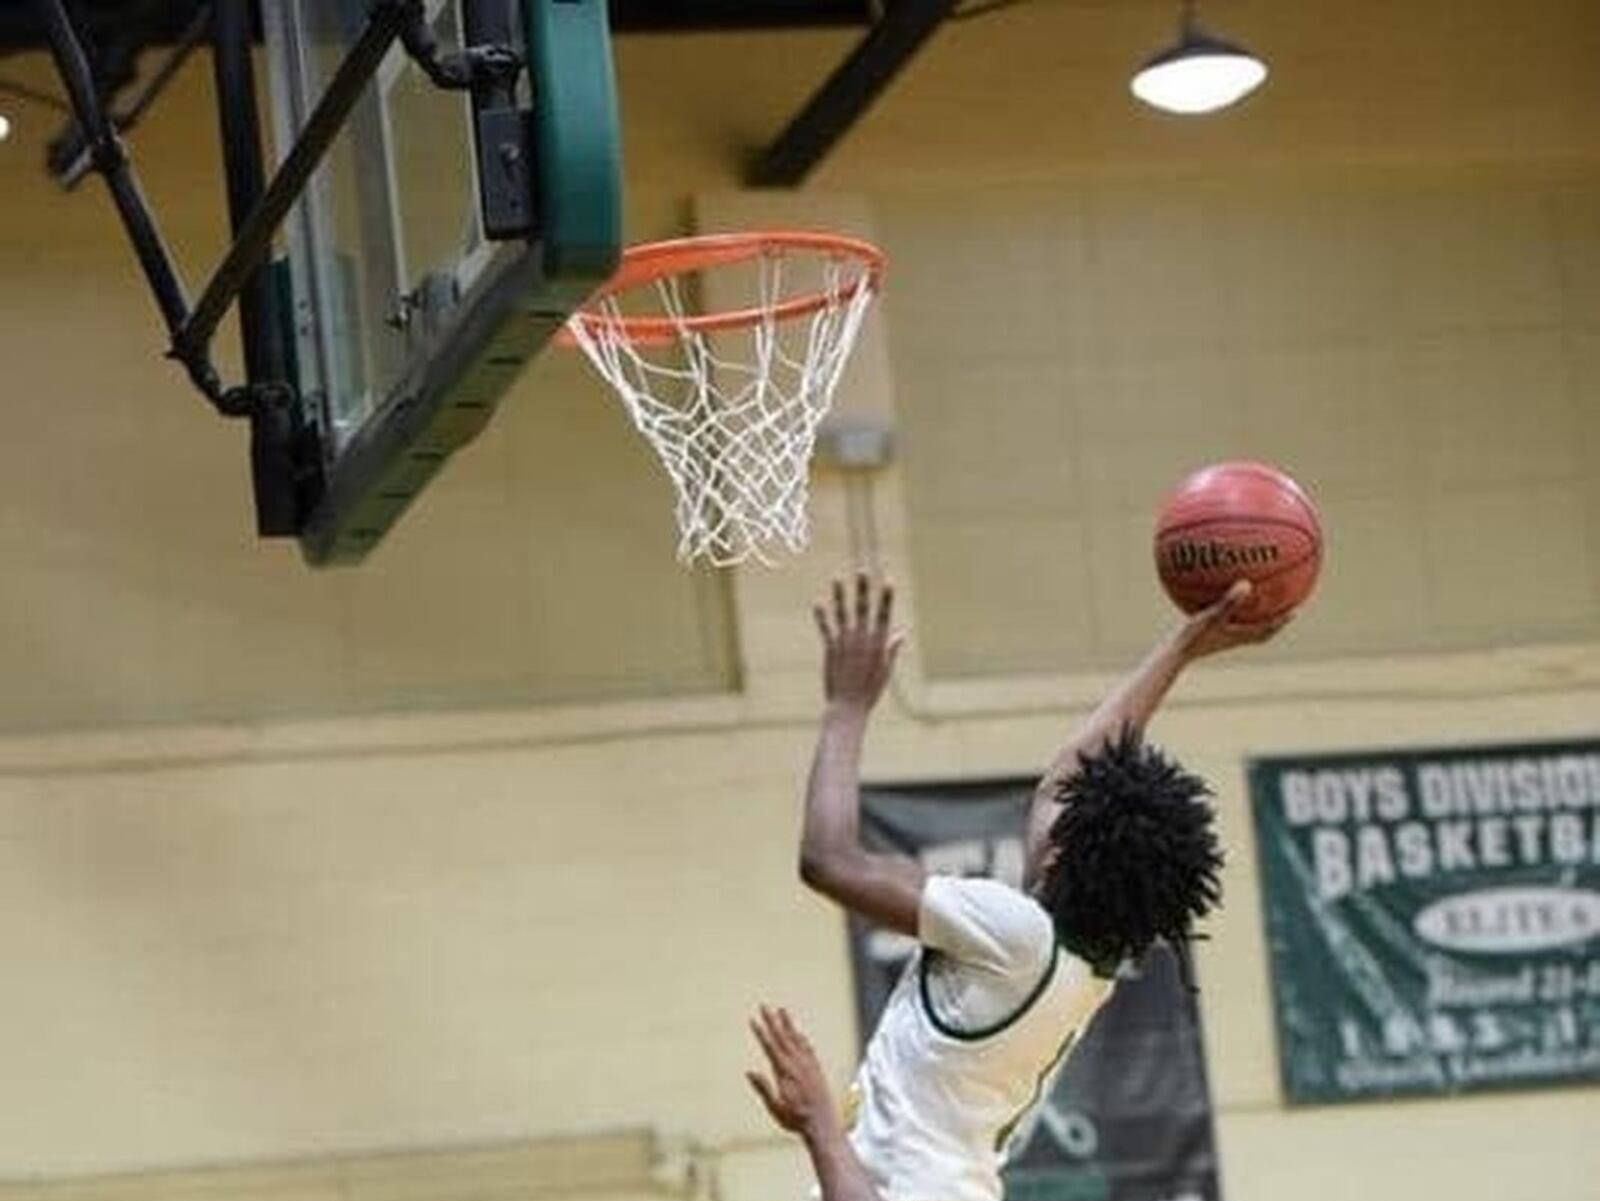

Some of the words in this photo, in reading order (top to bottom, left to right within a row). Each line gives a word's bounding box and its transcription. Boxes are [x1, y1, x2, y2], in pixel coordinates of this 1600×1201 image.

[1171, 539, 1278, 572] Wilson
[1282, 768, 1409, 825] BOYS
[1313, 815, 1600, 899] BASKETB
